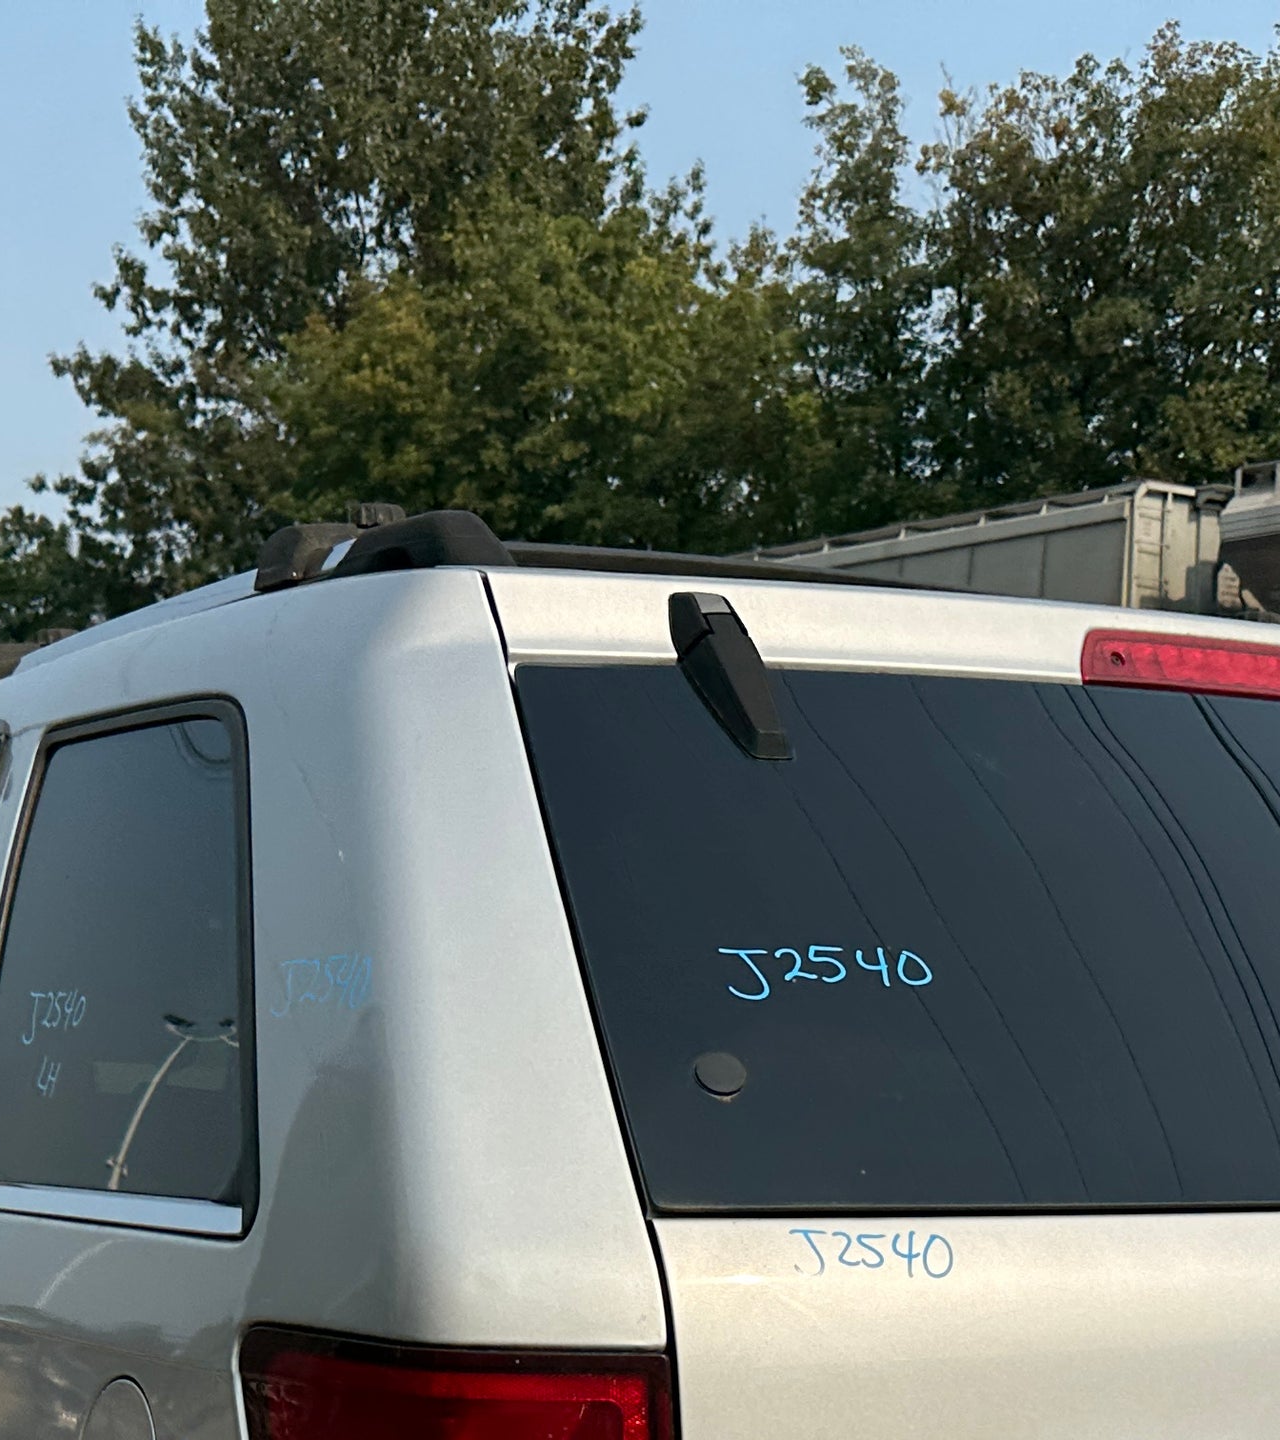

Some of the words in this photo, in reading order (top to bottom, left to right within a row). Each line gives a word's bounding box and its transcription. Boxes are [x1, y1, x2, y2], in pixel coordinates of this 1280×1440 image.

[718, 944, 934, 1001] J2540
[23, 990, 87, 1045] J2540
[789, 1228, 954, 1279] J2540
